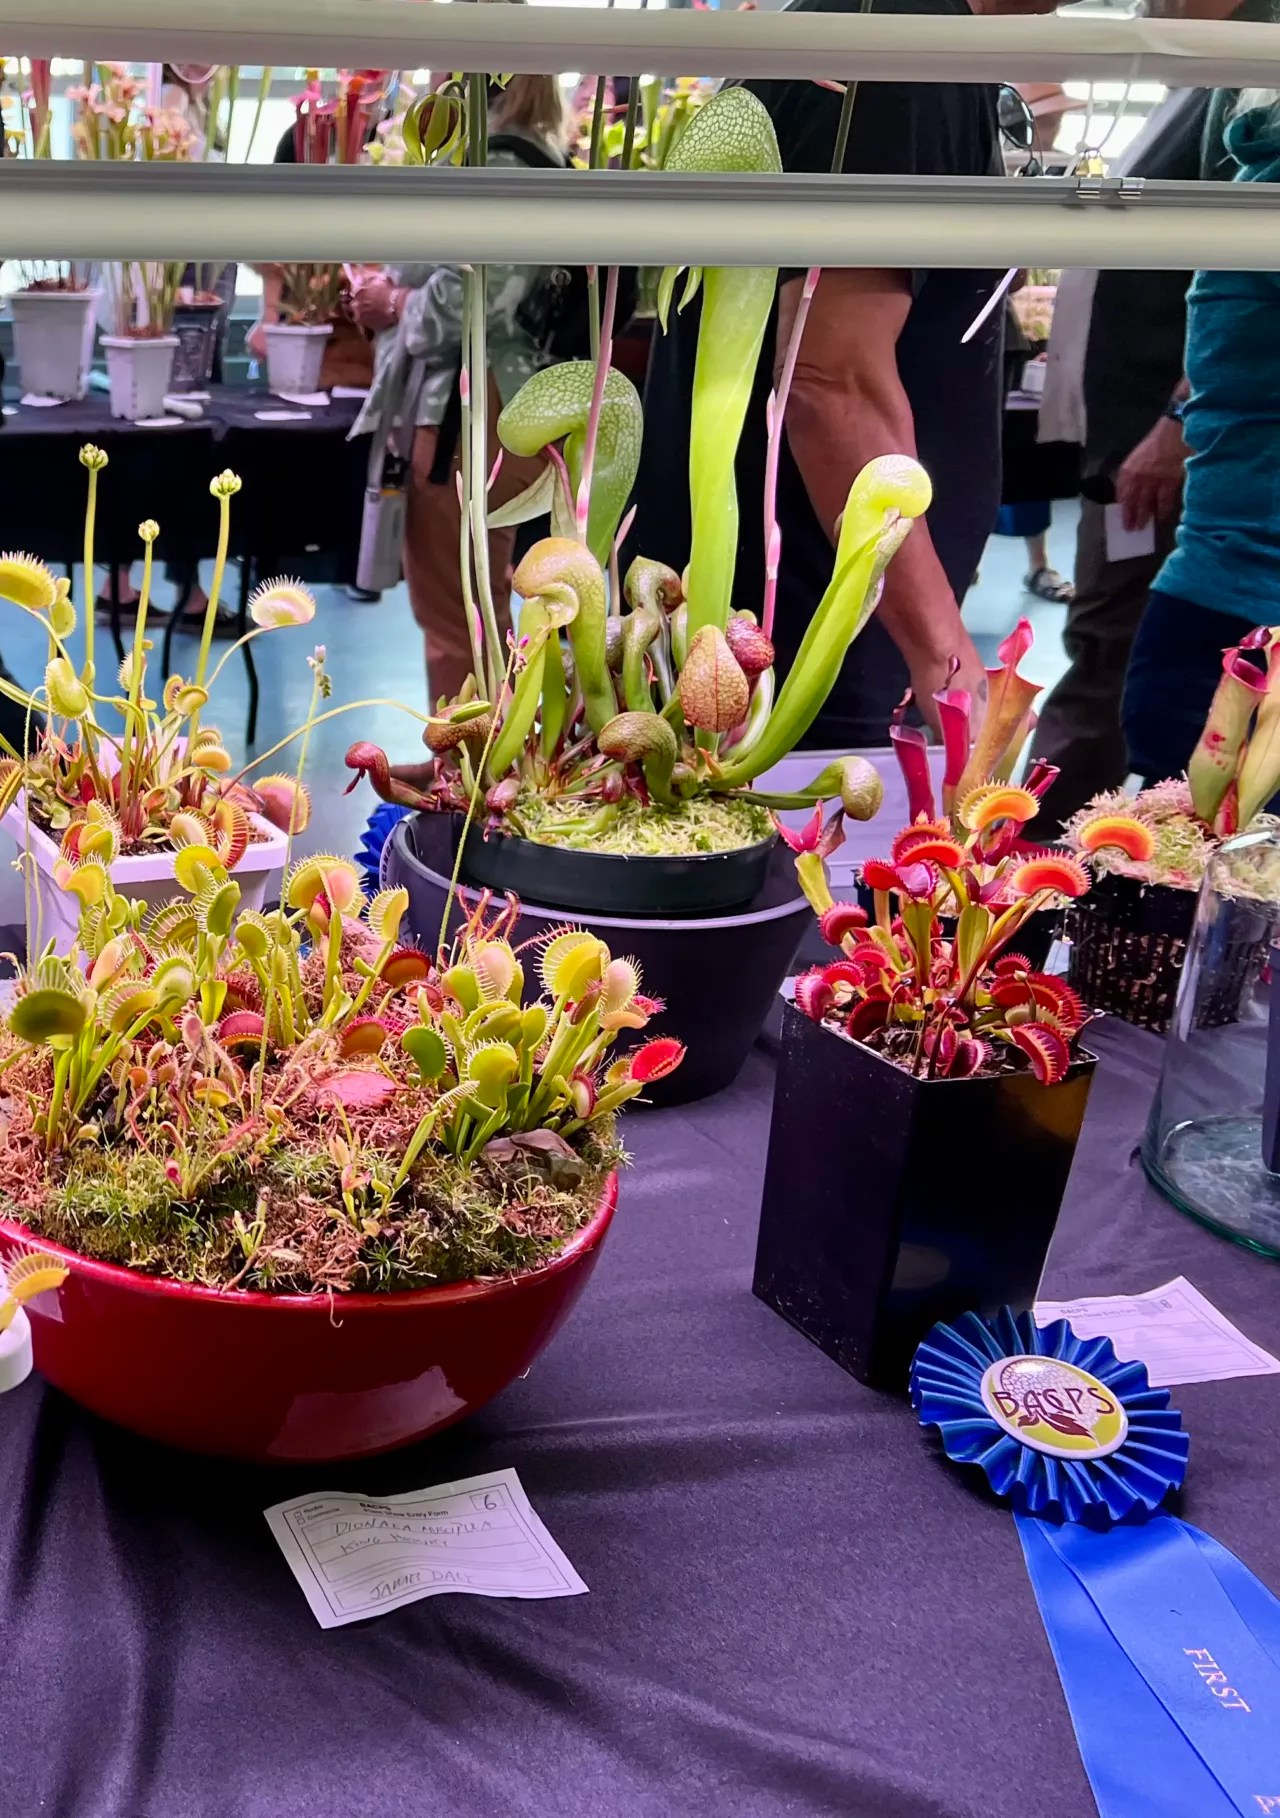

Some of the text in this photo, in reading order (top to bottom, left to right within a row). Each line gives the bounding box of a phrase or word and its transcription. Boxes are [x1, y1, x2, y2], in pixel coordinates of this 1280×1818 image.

[991, 1387, 1116, 1418] BACPS
[483, 1493, 497, 1511] 6
[1183, 1647, 1252, 1713] FIRST
